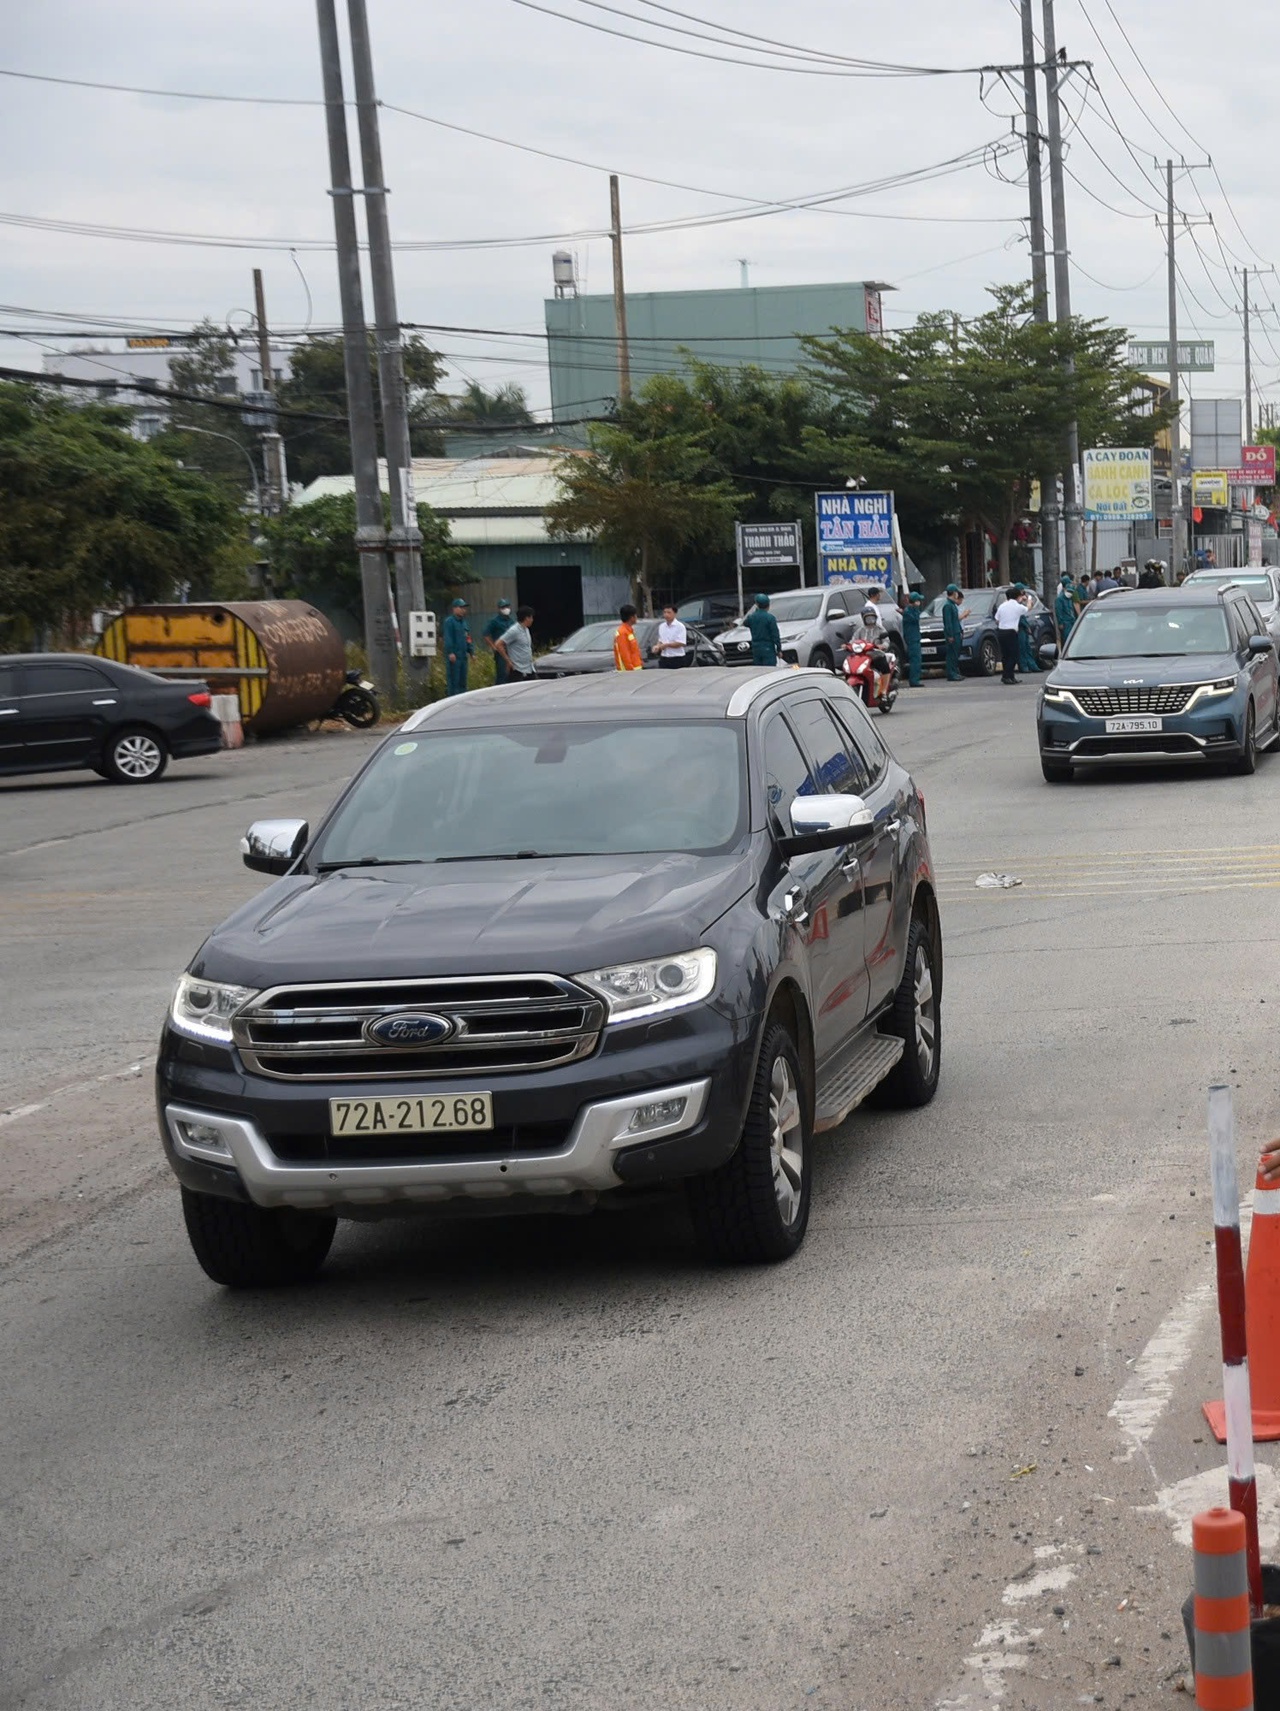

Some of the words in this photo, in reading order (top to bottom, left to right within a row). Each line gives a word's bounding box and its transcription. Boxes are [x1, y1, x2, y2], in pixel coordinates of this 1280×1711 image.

[822, 496, 851, 515] NHÀ
[854, 495, 888, 515] NGHỈ
[820, 515, 855, 539] TÂN
[857, 514, 890, 539] HẢI
[744, 535, 772, 548] THANH
[773, 532, 795, 548] THẢO
[827, 556, 858, 572] NHÀ
[860, 557, 888, 575] TRỌ
[1110, 720, 1158, 731] 72A-795.10
[387, 1020, 430, 1039] Ford
[335, 1098, 487, 1132] 72A-212.68
